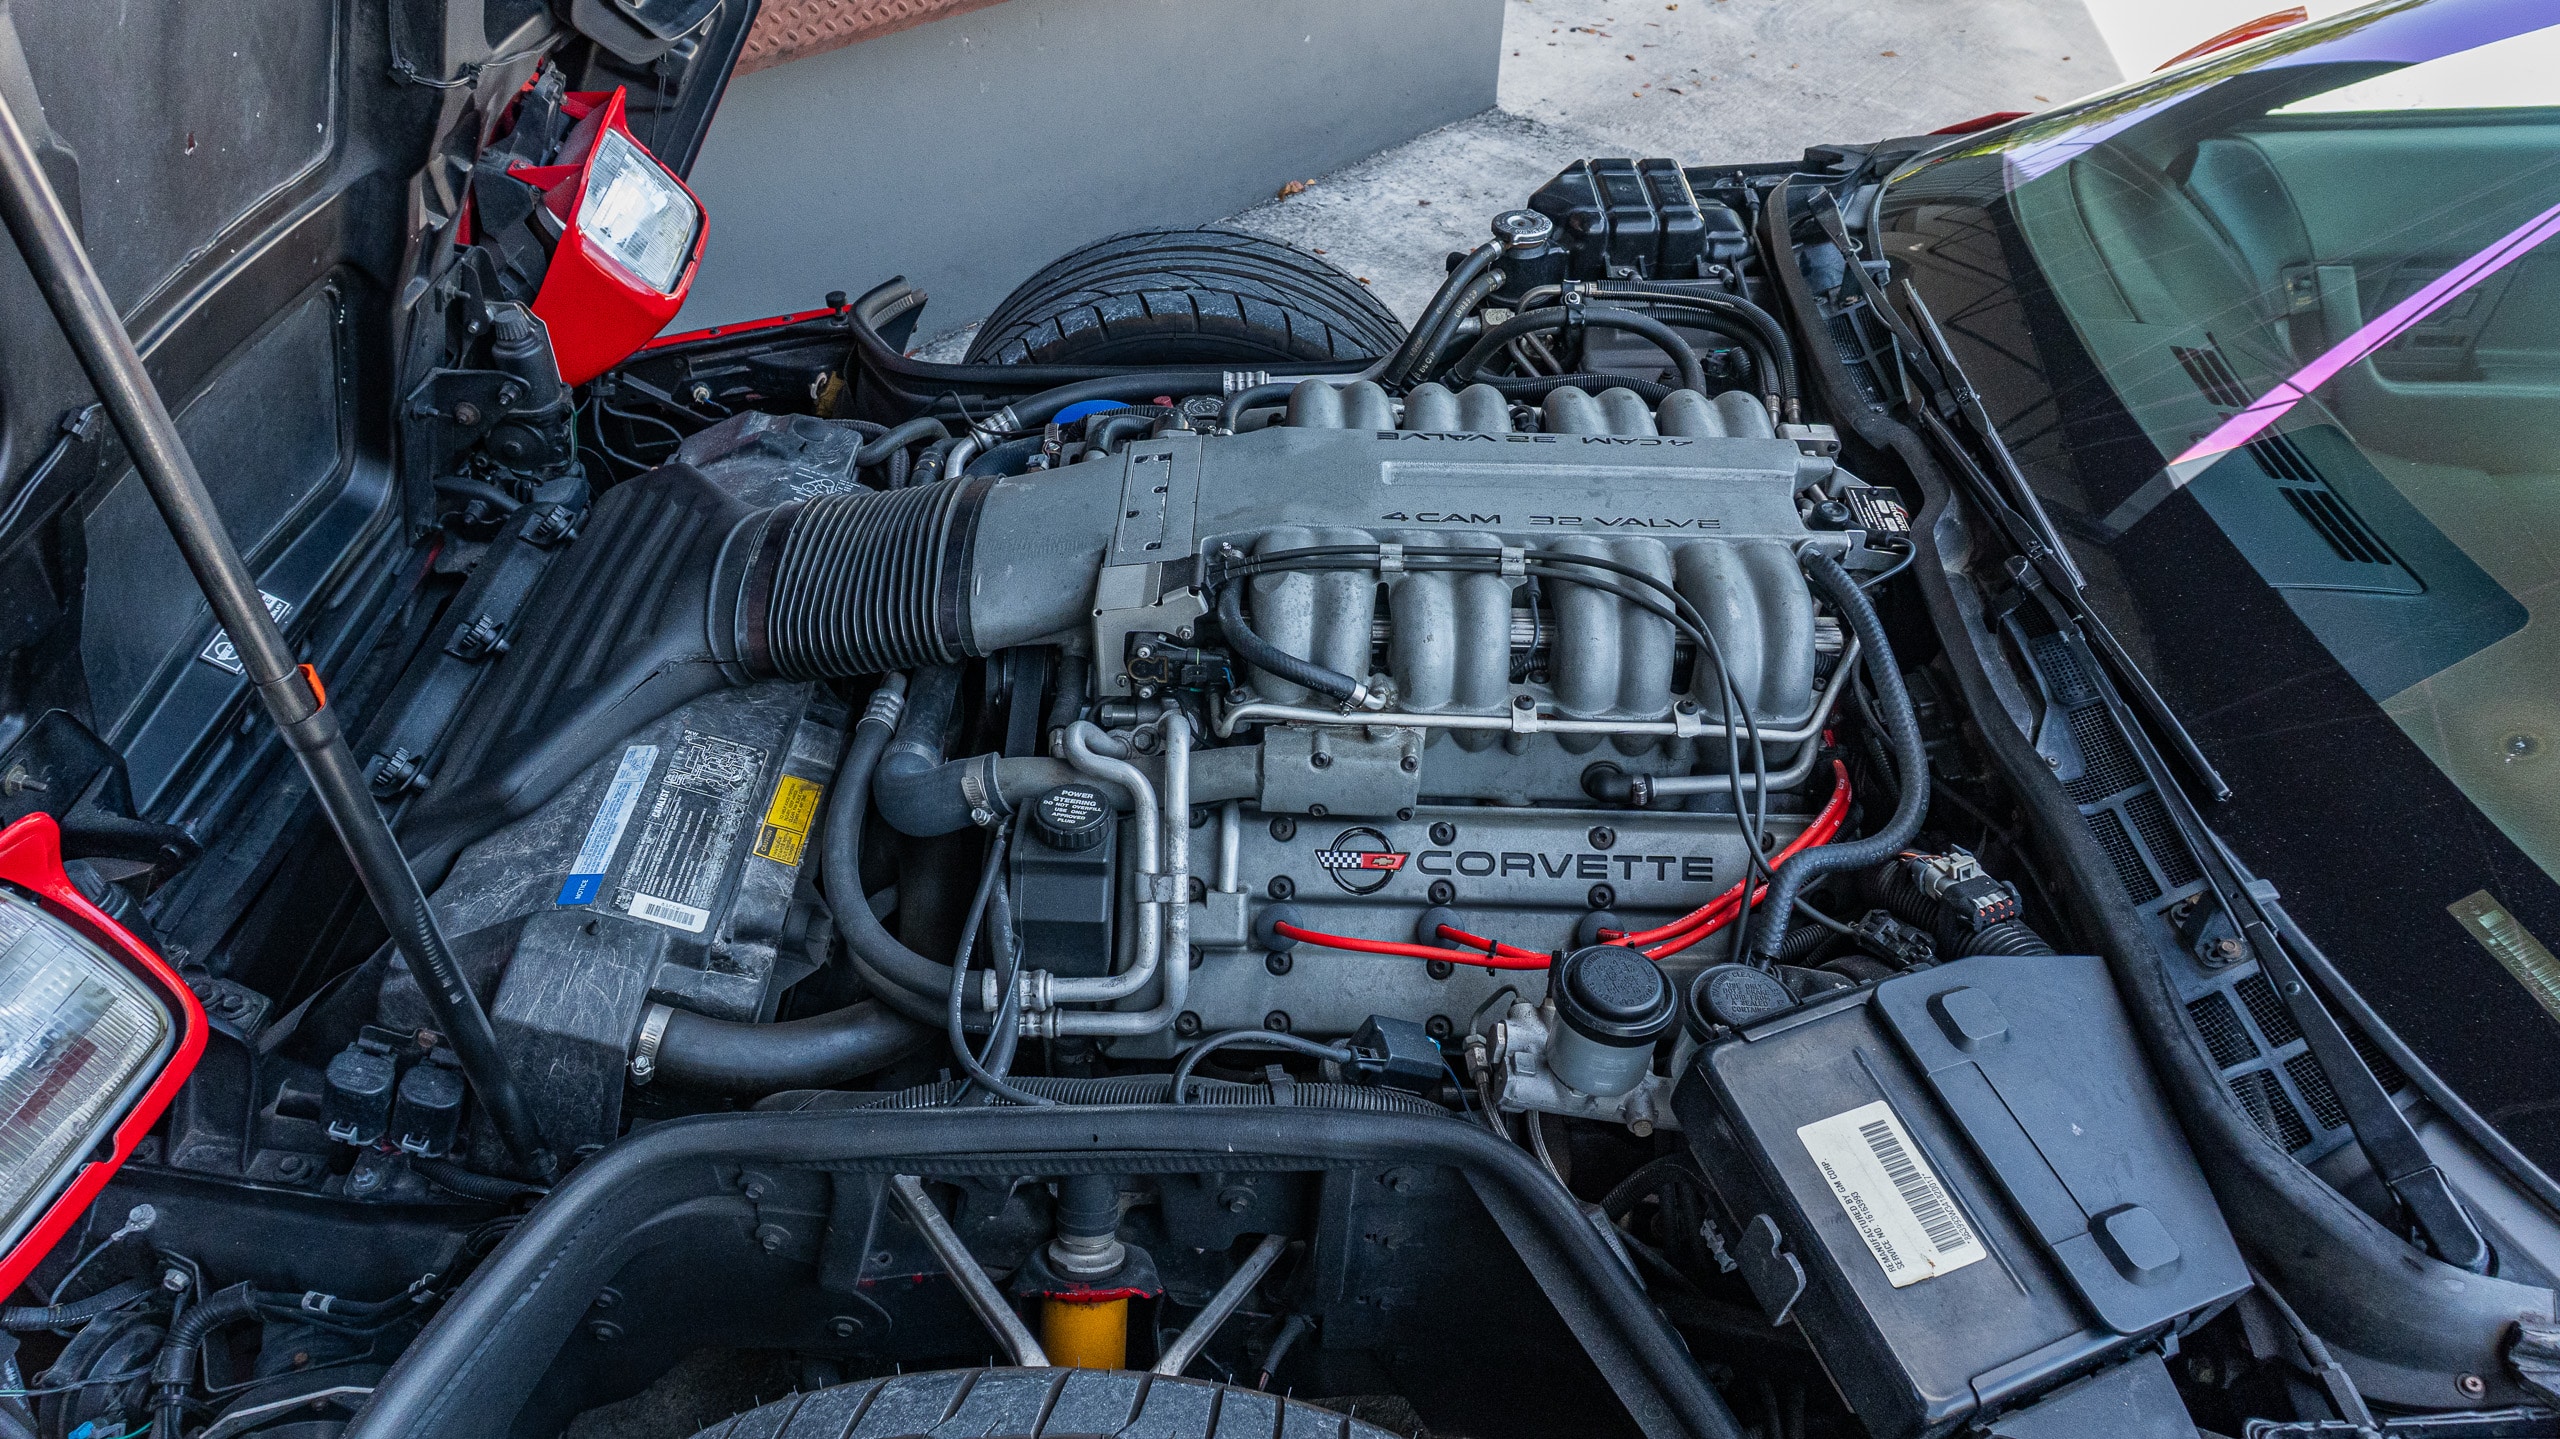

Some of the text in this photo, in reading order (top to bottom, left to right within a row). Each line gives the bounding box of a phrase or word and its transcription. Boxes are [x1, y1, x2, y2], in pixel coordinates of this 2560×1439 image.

[1376, 432, 1496, 442] VALVE
[1582, 437, 1662, 446] CAM
[1381, 511, 1721, 529] 4 CAM 32 VALVE
[651, 788, 669, 817] CATALYST
[1053, 796, 1097, 807] STEERING
[1061, 789, 1094, 799] POWER
[1051, 812, 1086, 820] APPROVED
[1071, 804, 1102, 812] OVERFILL
[1811, 798, 1838, 829] CORVETTE
[761, 830, 773, 852] CAUTION
[1416, 850, 1714, 882] CORVETTE
[574, 879, 588, 899] NOTICE
[1667, 903, 1710, 927] CORVETTE
[1821, 1157, 1895, 1273] REMANUFACTURED BY GM CORP.
[1850, 1191, 1905, 1270] SERVICE NO. 16163993
